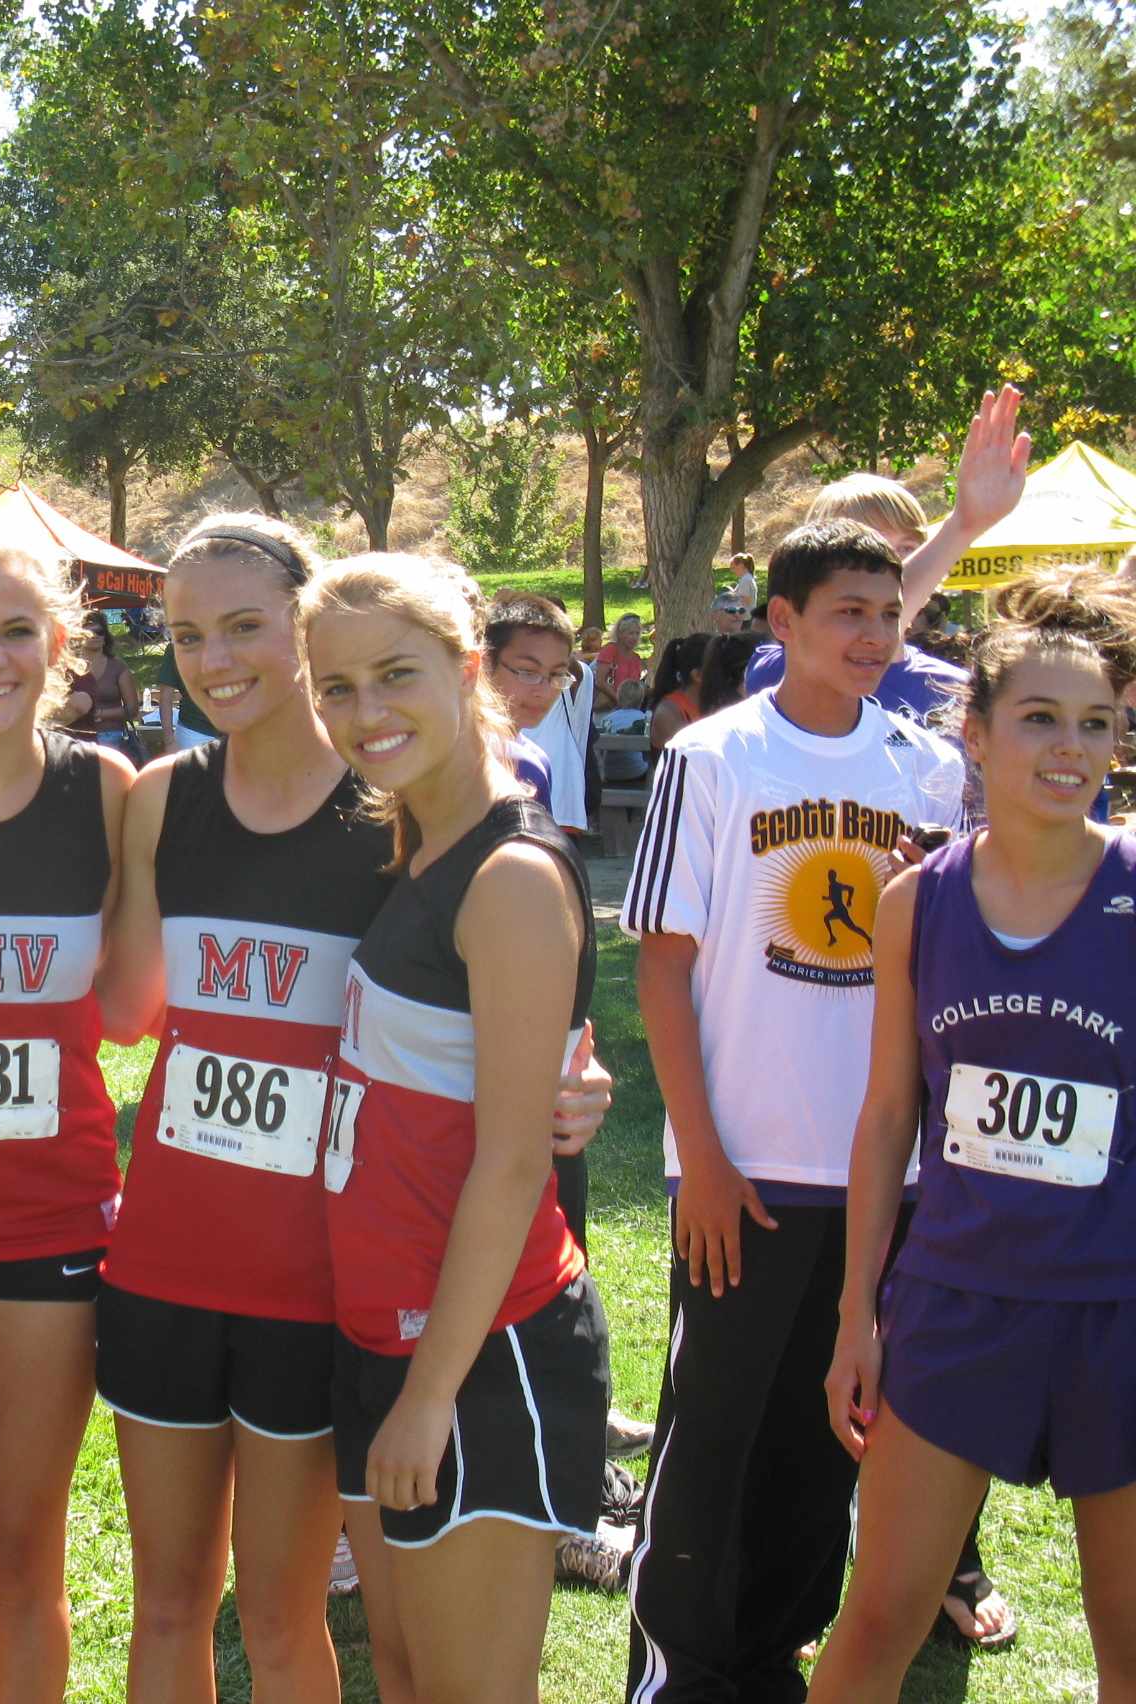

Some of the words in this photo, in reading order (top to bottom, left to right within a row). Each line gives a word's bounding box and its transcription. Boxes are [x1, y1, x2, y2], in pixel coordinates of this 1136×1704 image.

[948, 555, 1023, 577] CROSS
[750, 797, 836, 857] Scott
[198, 933, 309, 1007] MV
[771, 959, 824, 979] HARRIER
[931, 994, 1042, 1034] COLLEGE
[1050, 998, 1124, 1045] PARK
[193, 1055, 289, 1133] 986
[977, 1072, 1078, 1146] 309
